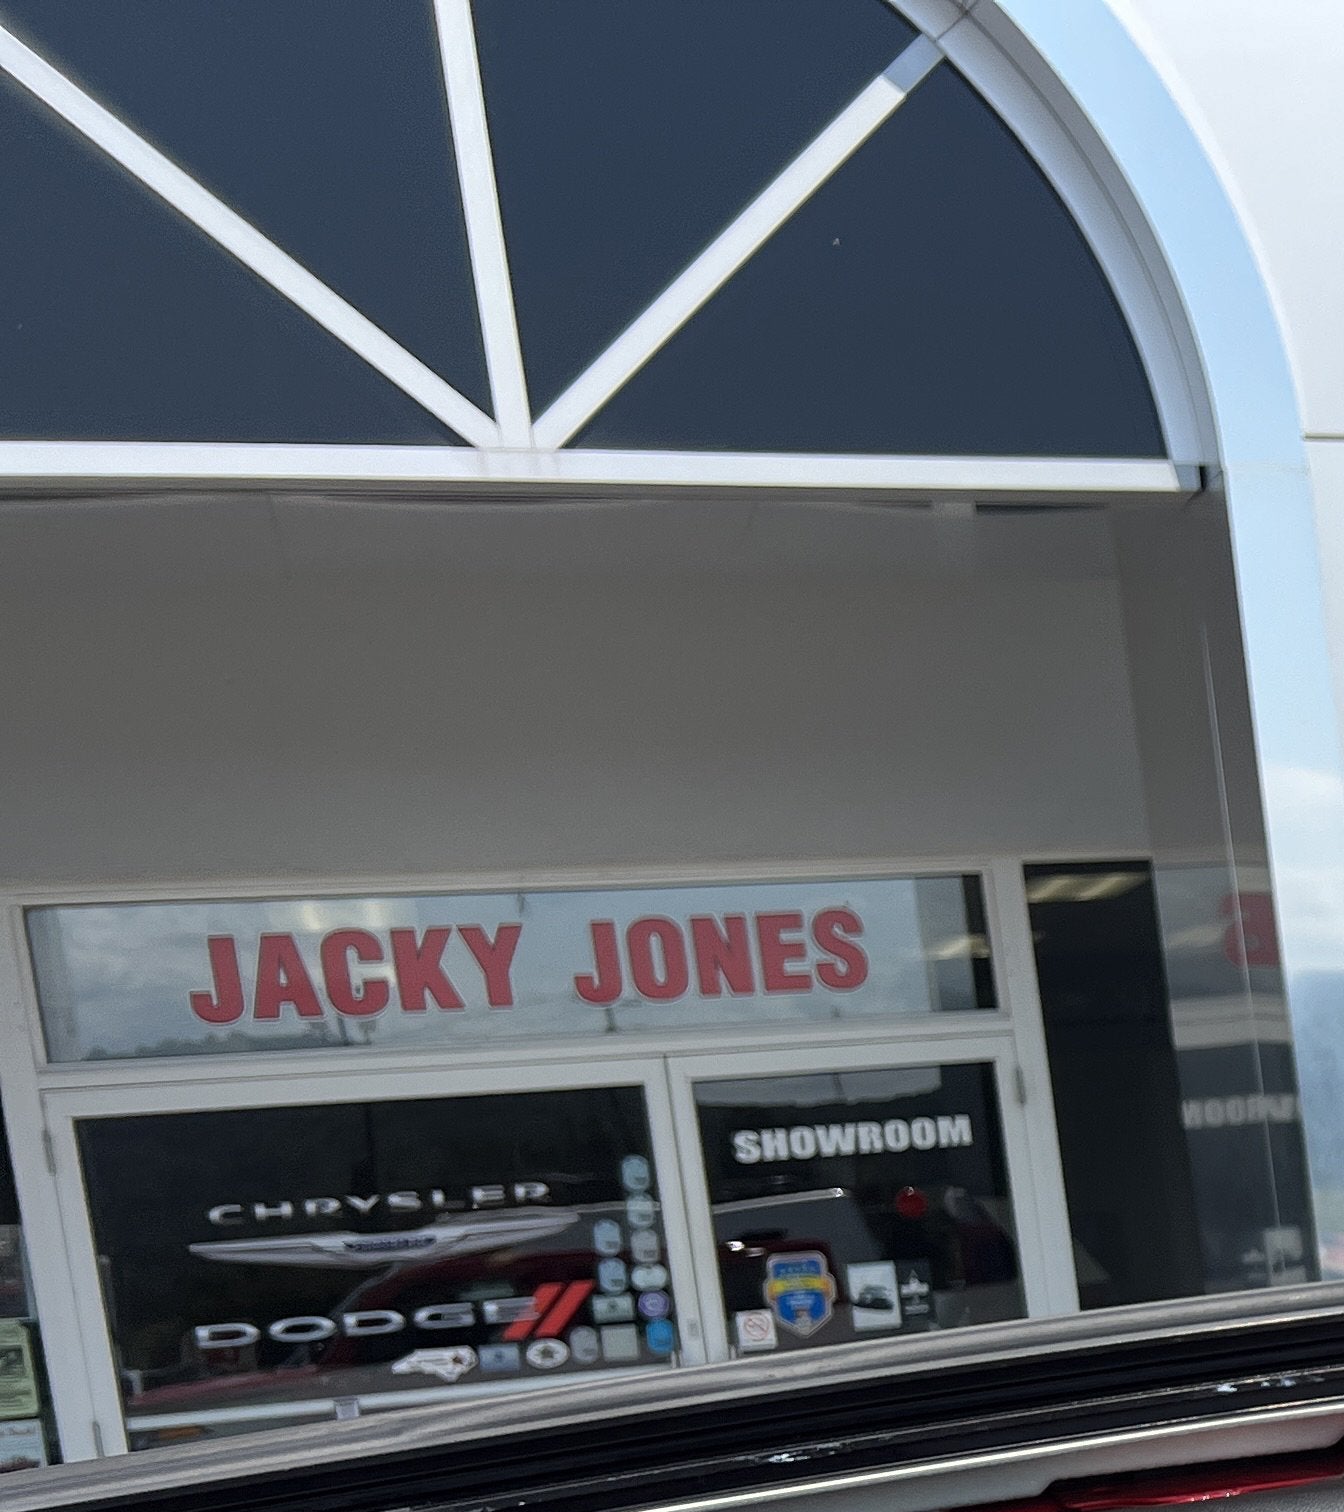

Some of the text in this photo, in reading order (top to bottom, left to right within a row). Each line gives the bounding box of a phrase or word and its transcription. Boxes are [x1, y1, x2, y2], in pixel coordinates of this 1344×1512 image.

[189, 907, 870, 1026] JACKY JONES
[732, 1112, 974, 1165] SHOWROOM
[208, 1181, 551, 1226] CHRYSLER
[195, 1295, 540, 1350] DODGE
